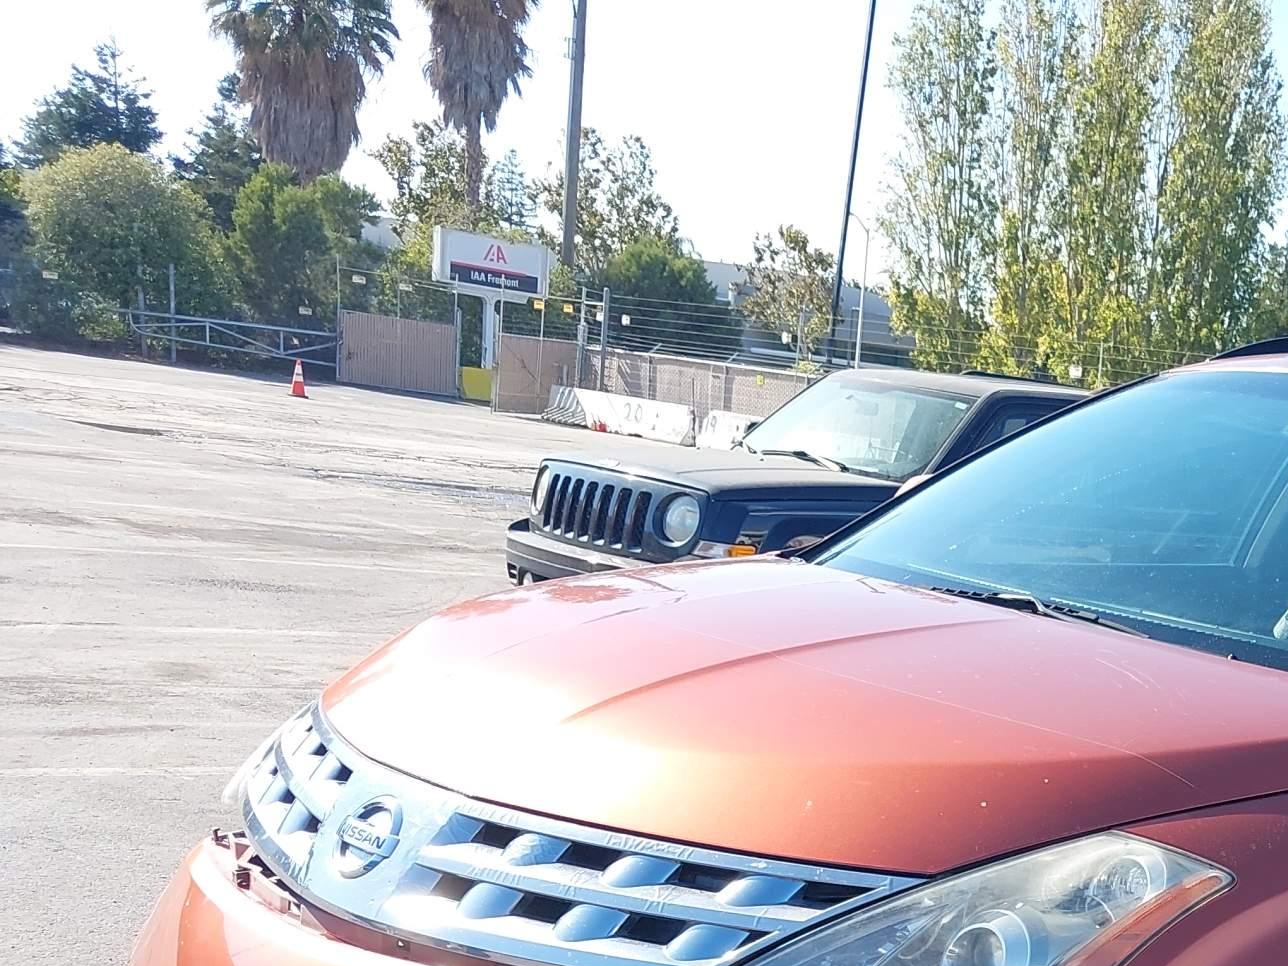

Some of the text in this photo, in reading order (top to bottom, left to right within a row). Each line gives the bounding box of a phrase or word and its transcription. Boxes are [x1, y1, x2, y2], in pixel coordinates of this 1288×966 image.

[470, 270, 519, 288] IAA Fremont
[623, 402, 643, 424] 20
[336, 820, 387, 850] NISSAN
